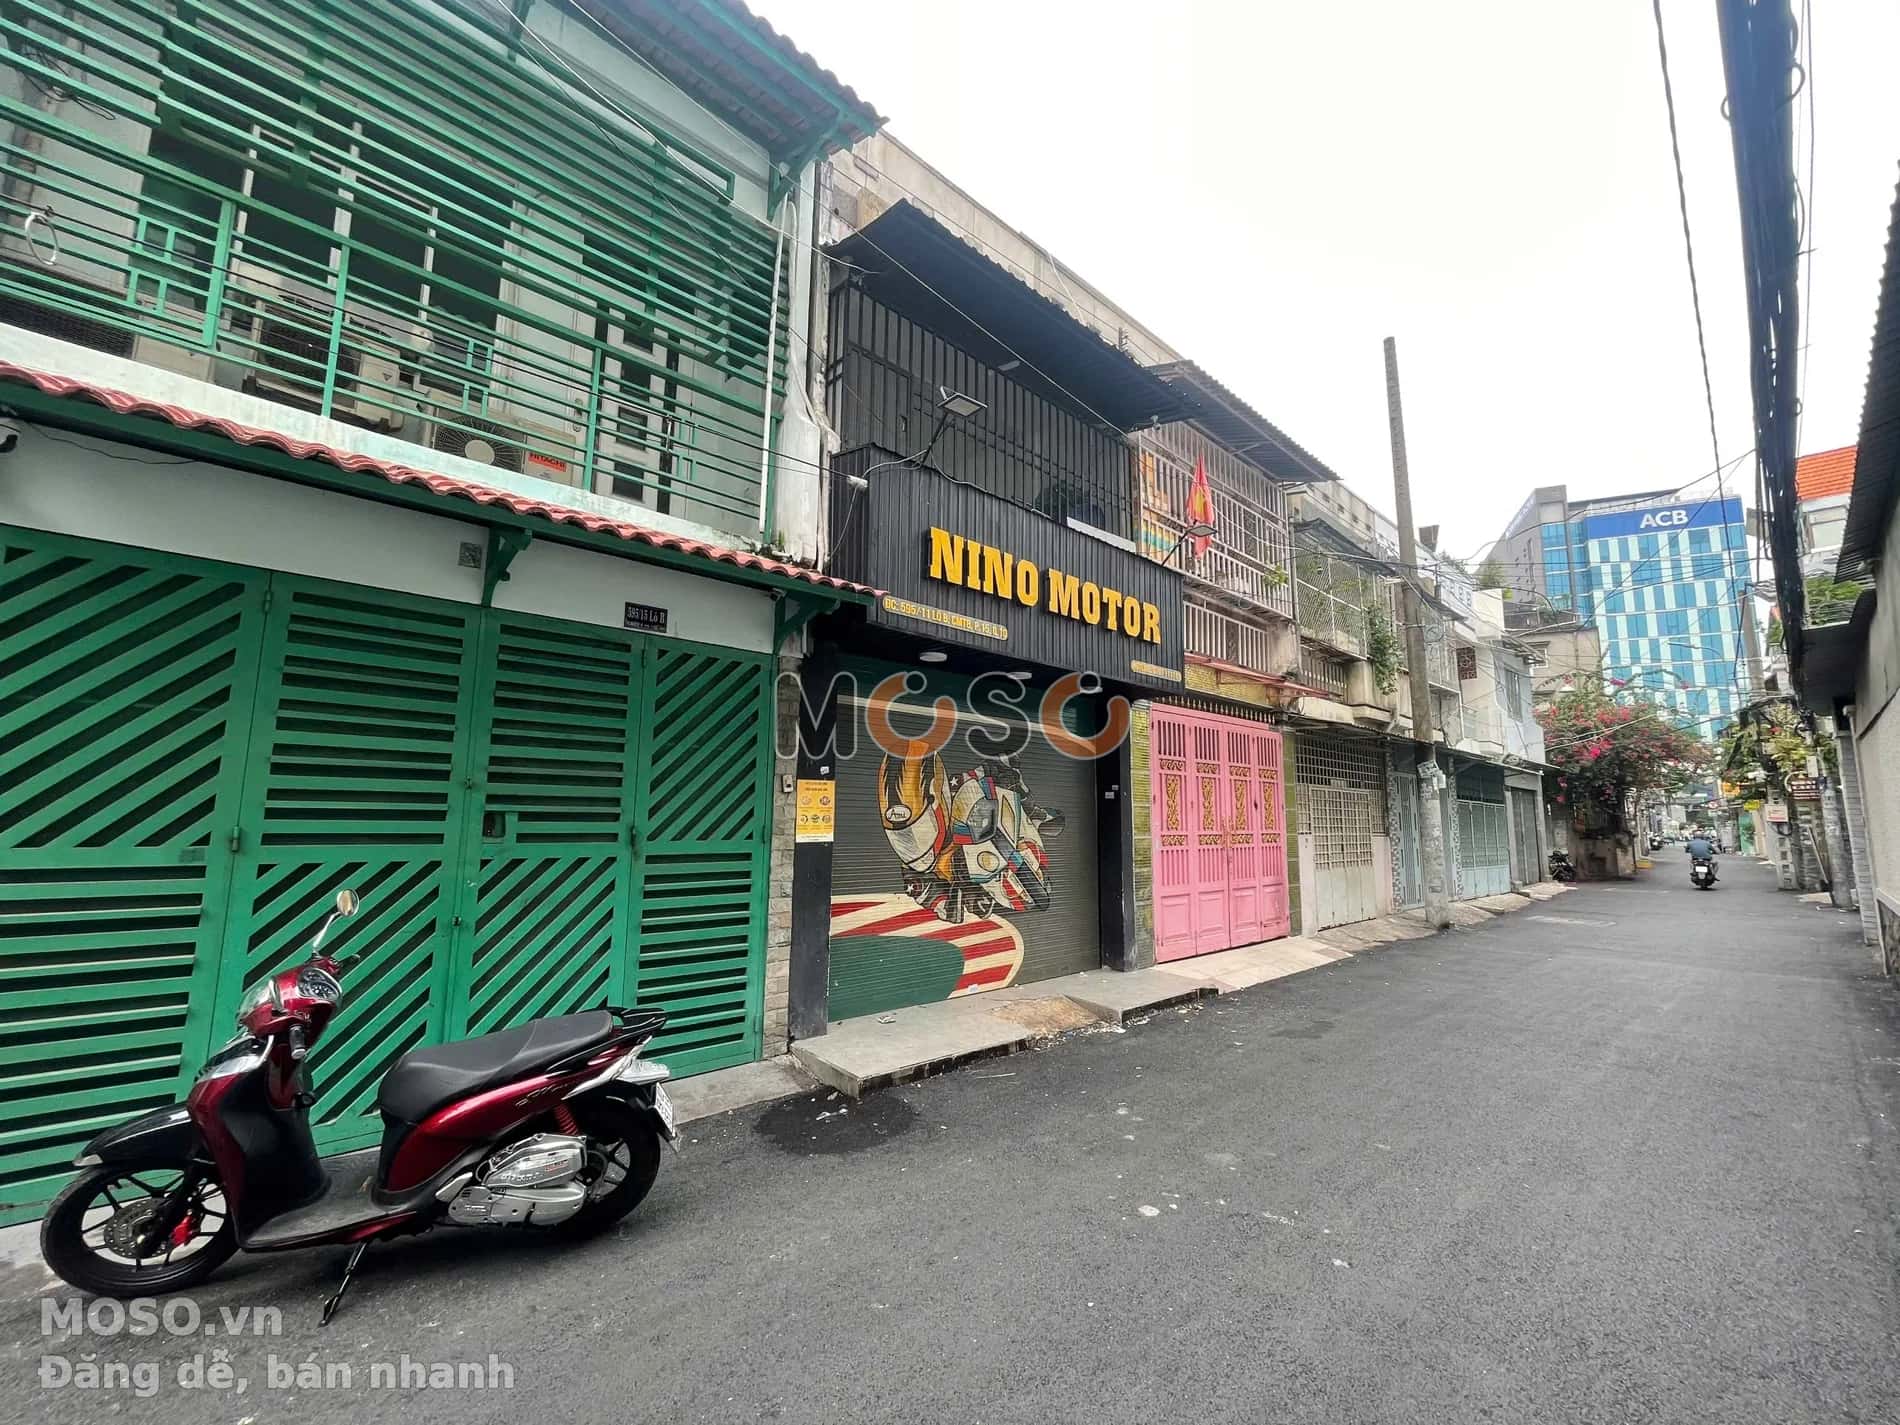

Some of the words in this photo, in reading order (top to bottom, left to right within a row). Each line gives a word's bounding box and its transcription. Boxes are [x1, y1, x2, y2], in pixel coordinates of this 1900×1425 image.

[1640, 510, 1689, 529] ACB
[928, 526, 1039, 607] NINO
[1048, 567, 1161, 644] MOTOR
